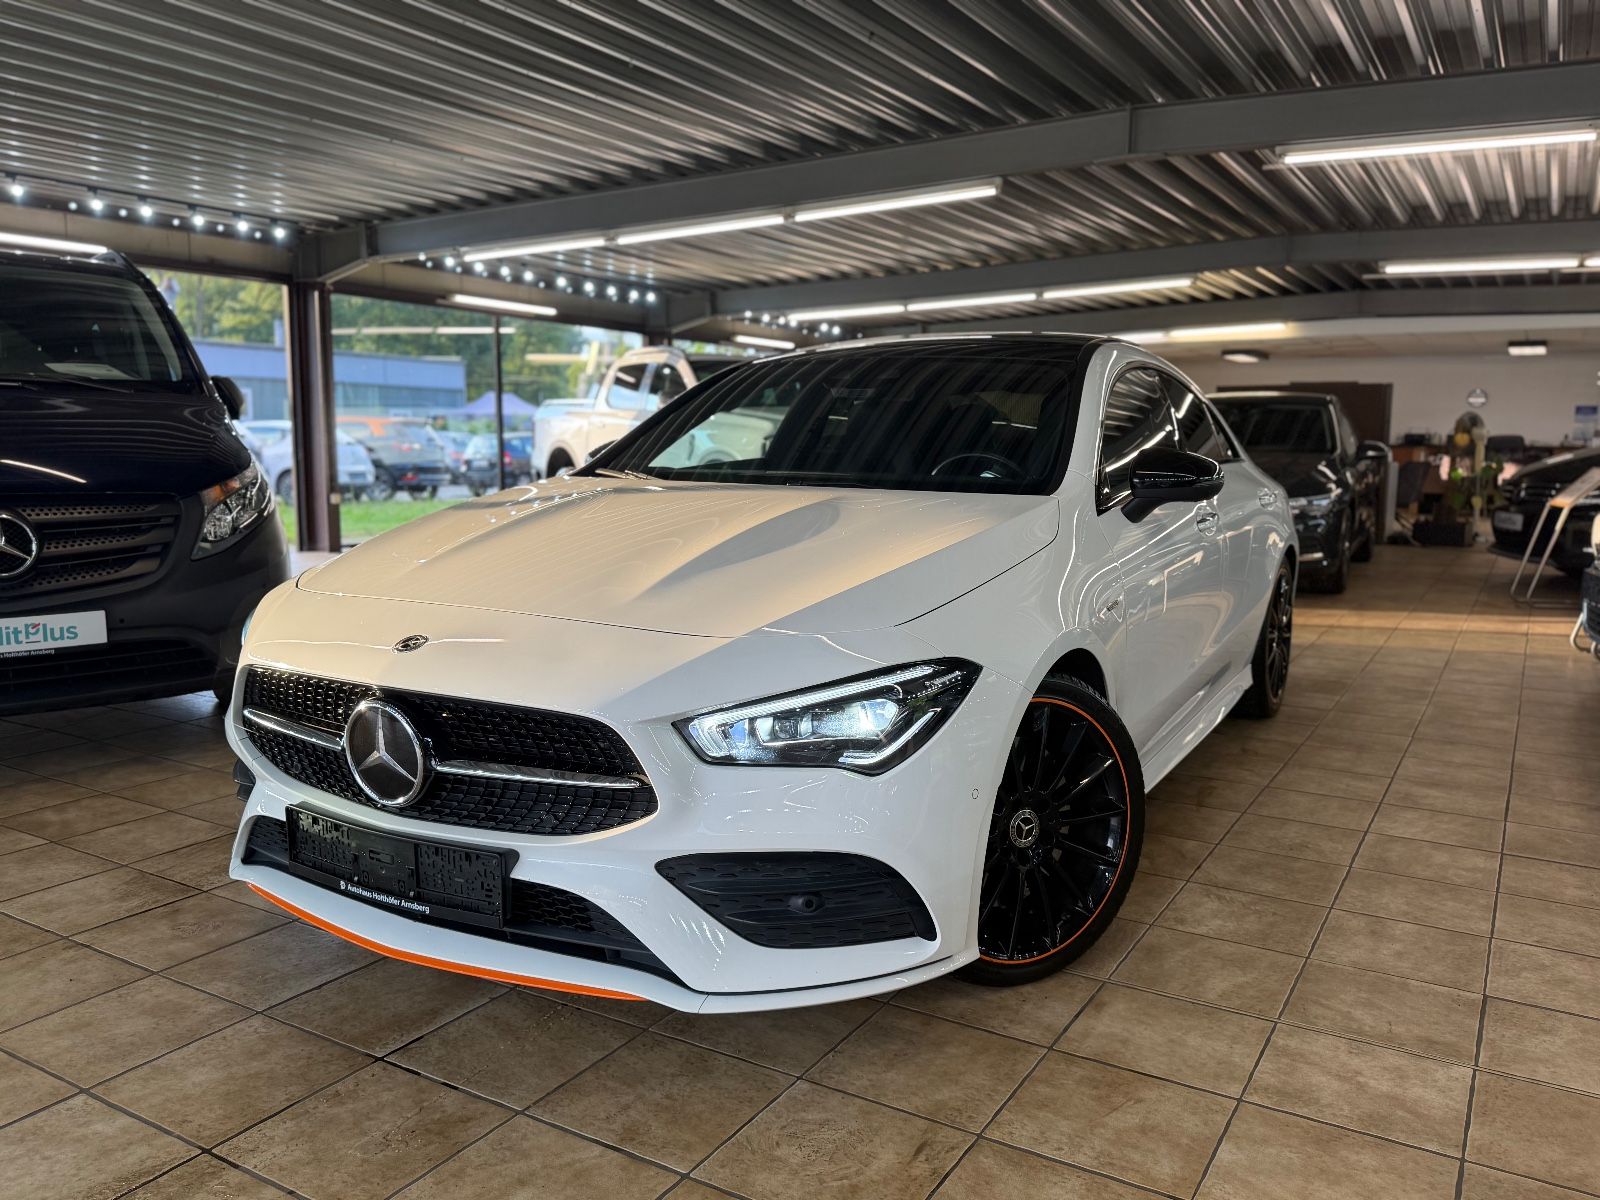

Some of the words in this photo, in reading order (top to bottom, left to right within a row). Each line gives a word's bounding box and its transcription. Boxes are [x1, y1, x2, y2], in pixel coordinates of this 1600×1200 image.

[0, 623, 79, 646] itPlus
[347, 884, 373, 898] Autohaus
[372, 892, 401, 906] Holthöfer
[401, 900, 430, 914] Arnsberg
